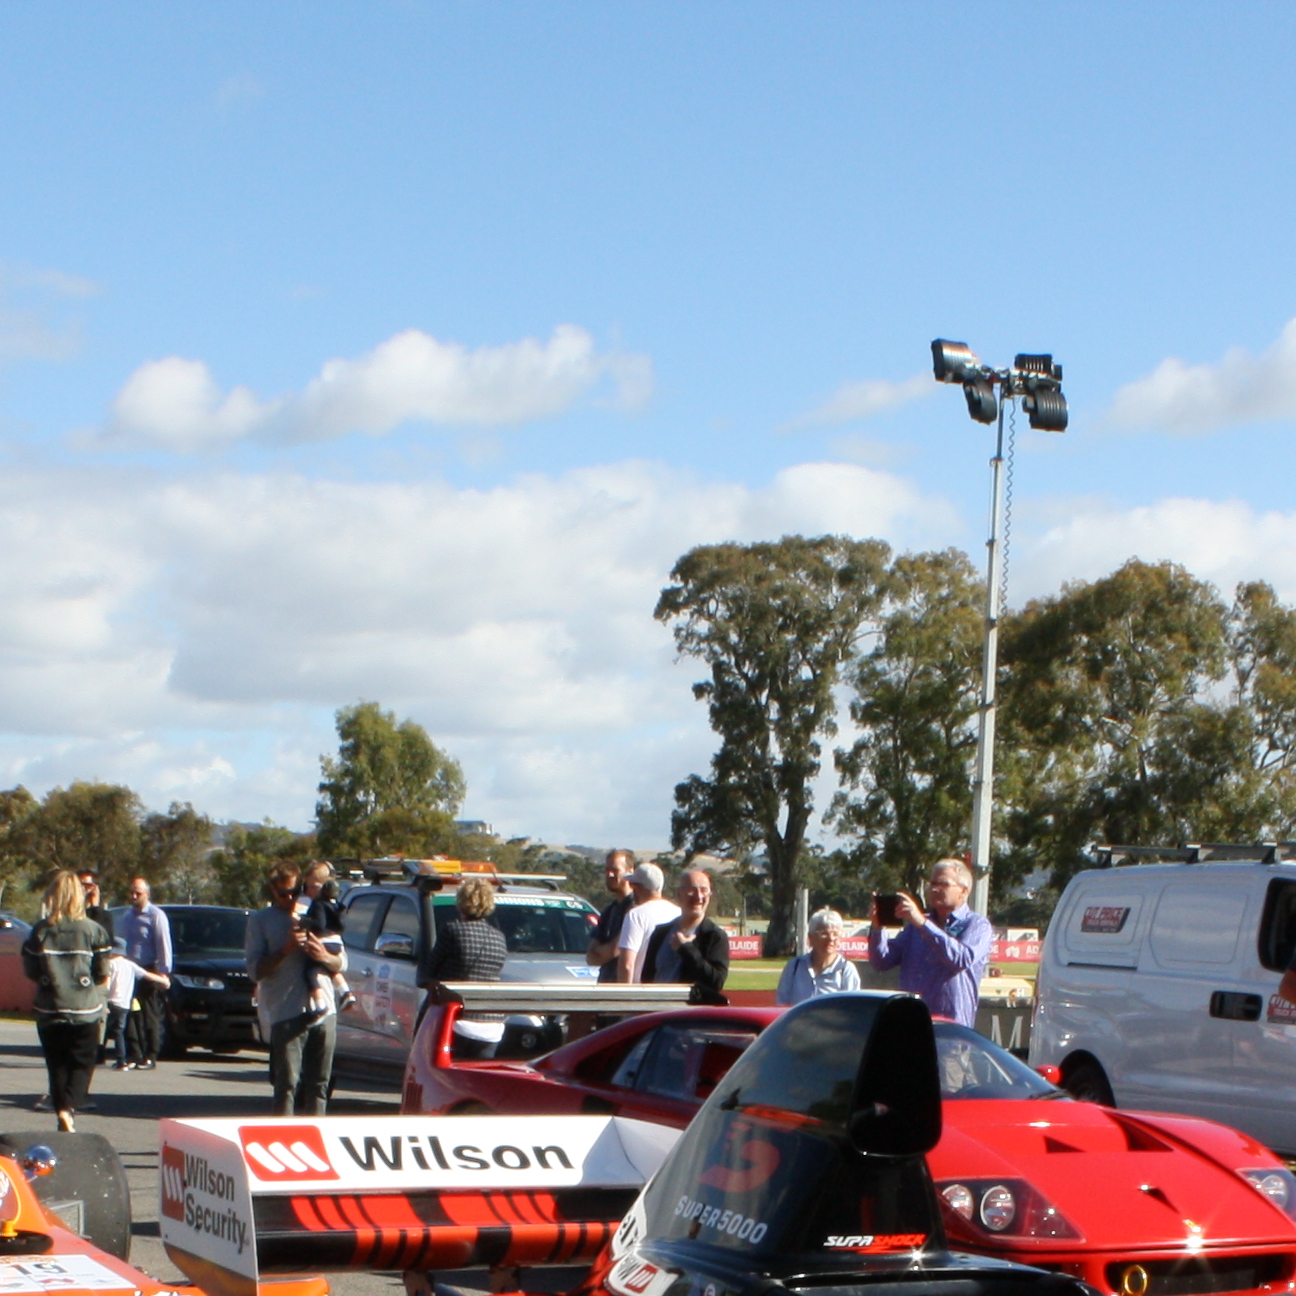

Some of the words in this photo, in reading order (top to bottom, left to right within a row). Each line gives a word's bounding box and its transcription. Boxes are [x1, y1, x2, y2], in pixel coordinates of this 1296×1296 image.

[728, 940, 759, 951] ELAIDE
[338, 1135, 575, 1171] Wilson
[184, 1153, 235, 1201] Wilson
[184, 1198, 247, 1255] Security
[674, 1195, 768, 1245] SUPER5000
[823, 1233, 928, 1248] SUPASHOCK
